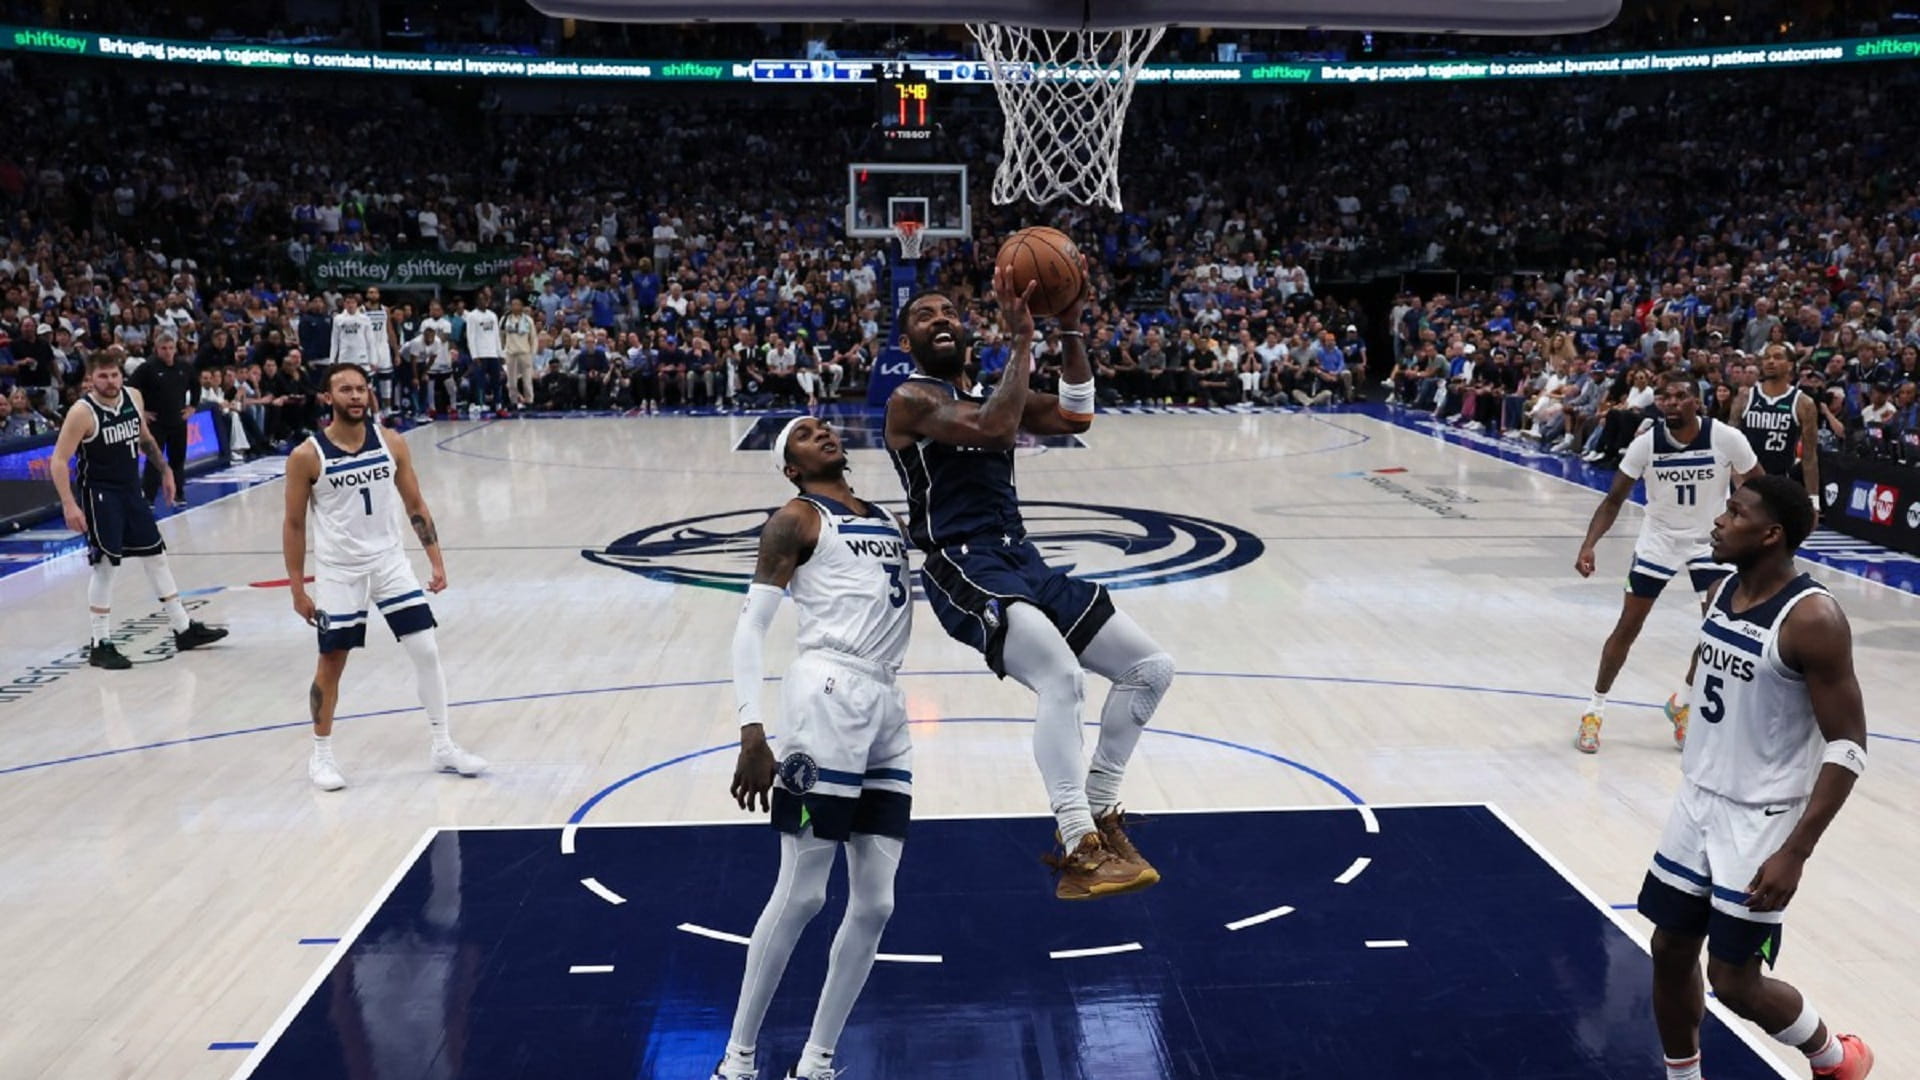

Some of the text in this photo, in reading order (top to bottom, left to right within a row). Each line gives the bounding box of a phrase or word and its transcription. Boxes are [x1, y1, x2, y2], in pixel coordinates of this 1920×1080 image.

[14, 30, 86, 53] shiftkey
[1856, 37, 1920, 58] shiftkey
[98, 37, 651, 76] Bringing people together to combat burnout and improve patient outcomes
[1321, 46, 1843, 82] Bringing people together to combat burnout and improve patient outcomes
[662, 62, 722, 79] shiftkey
[1172, 67, 1241, 80] outcomes
[1252, 65, 1311, 82] shiftkey
[895, 84, 927, 99] 7:48
[317, 259, 390, 281] shiftkey
[397, 258, 465, 280] shiftkey
[1746, 410, 1791, 430] MAVS
[102, 417, 140, 445] MAVS
[1765, 431, 1787, 451] 25
[329, 466, 389, 488] WOLVES
[1656, 468, 1714, 482] WOLVES
[360, 487, 372, 516] 1
[1675, 484, 1696, 505] 11
[845, 540, 908, 560] WOLVE
[882, 563, 906, 608] 3
[1700, 674, 1725, 724] 5
